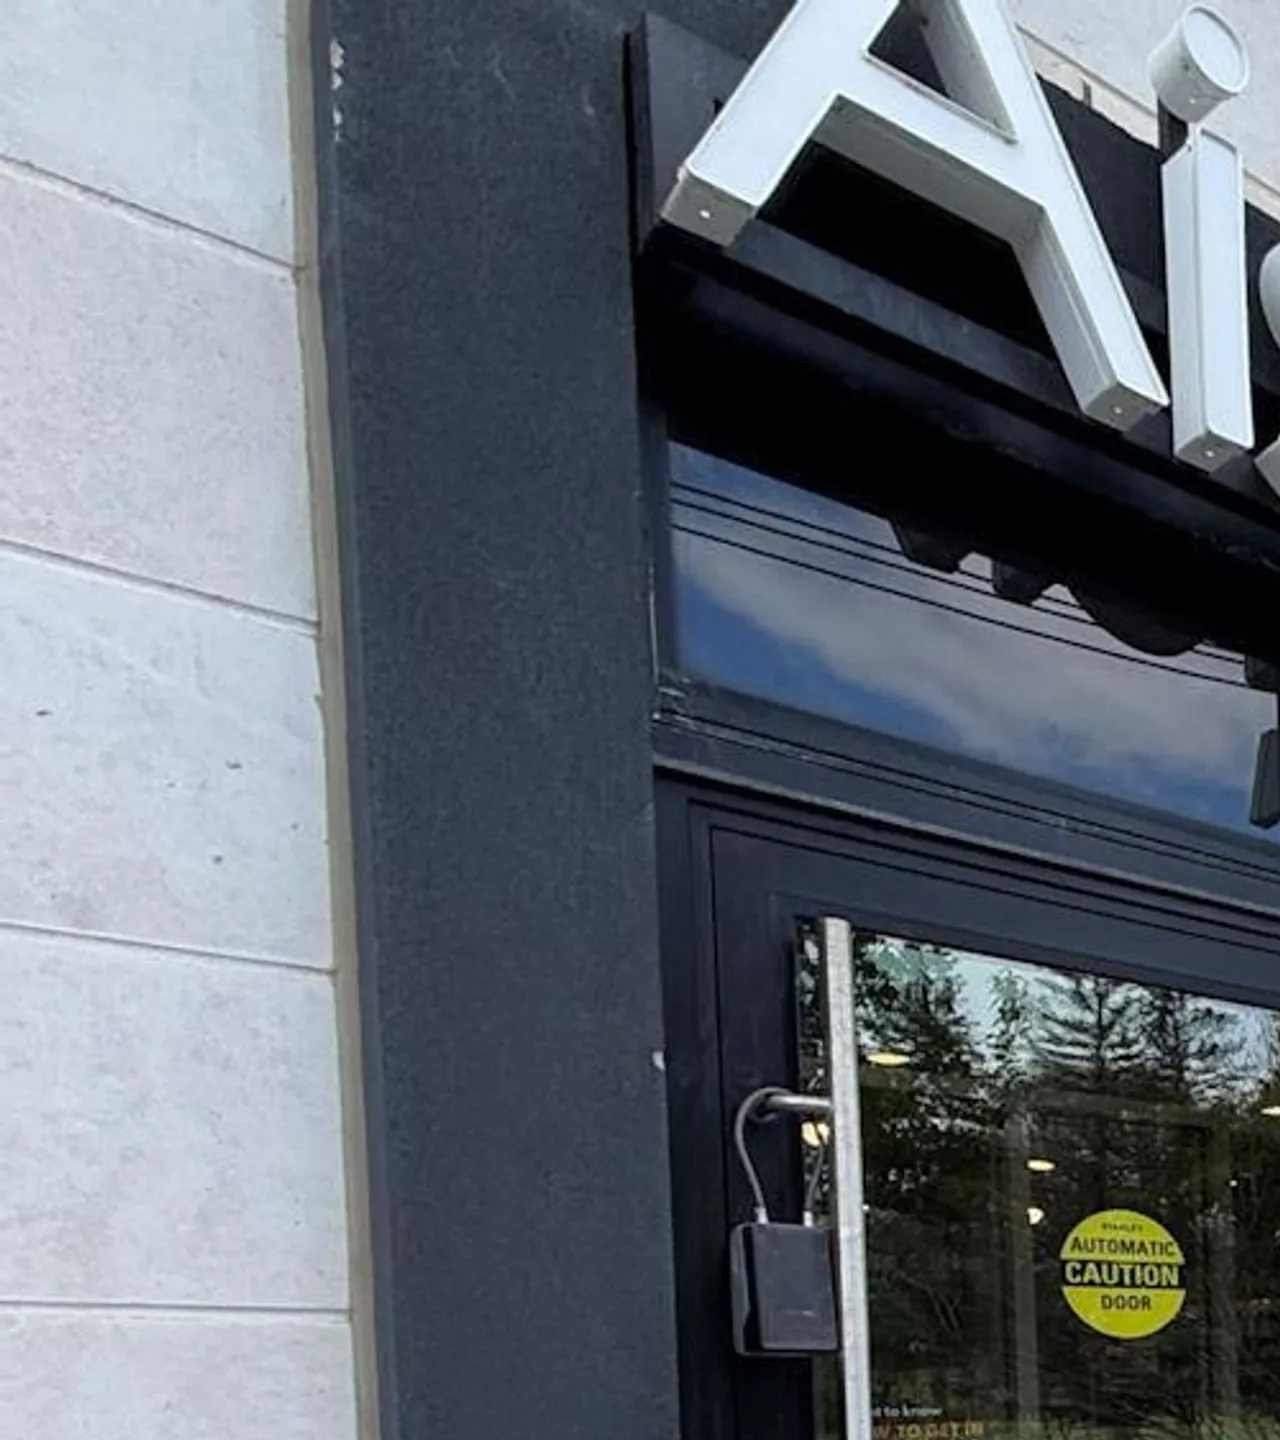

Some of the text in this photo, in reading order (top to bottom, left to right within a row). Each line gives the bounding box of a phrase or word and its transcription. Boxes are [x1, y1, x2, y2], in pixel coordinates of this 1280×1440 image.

[1069, 1236, 1178, 1257] AUTOMATIC
[1064, 1261, 1180, 1287] CAUTION
[1101, 1295, 1152, 1311] DOOR
